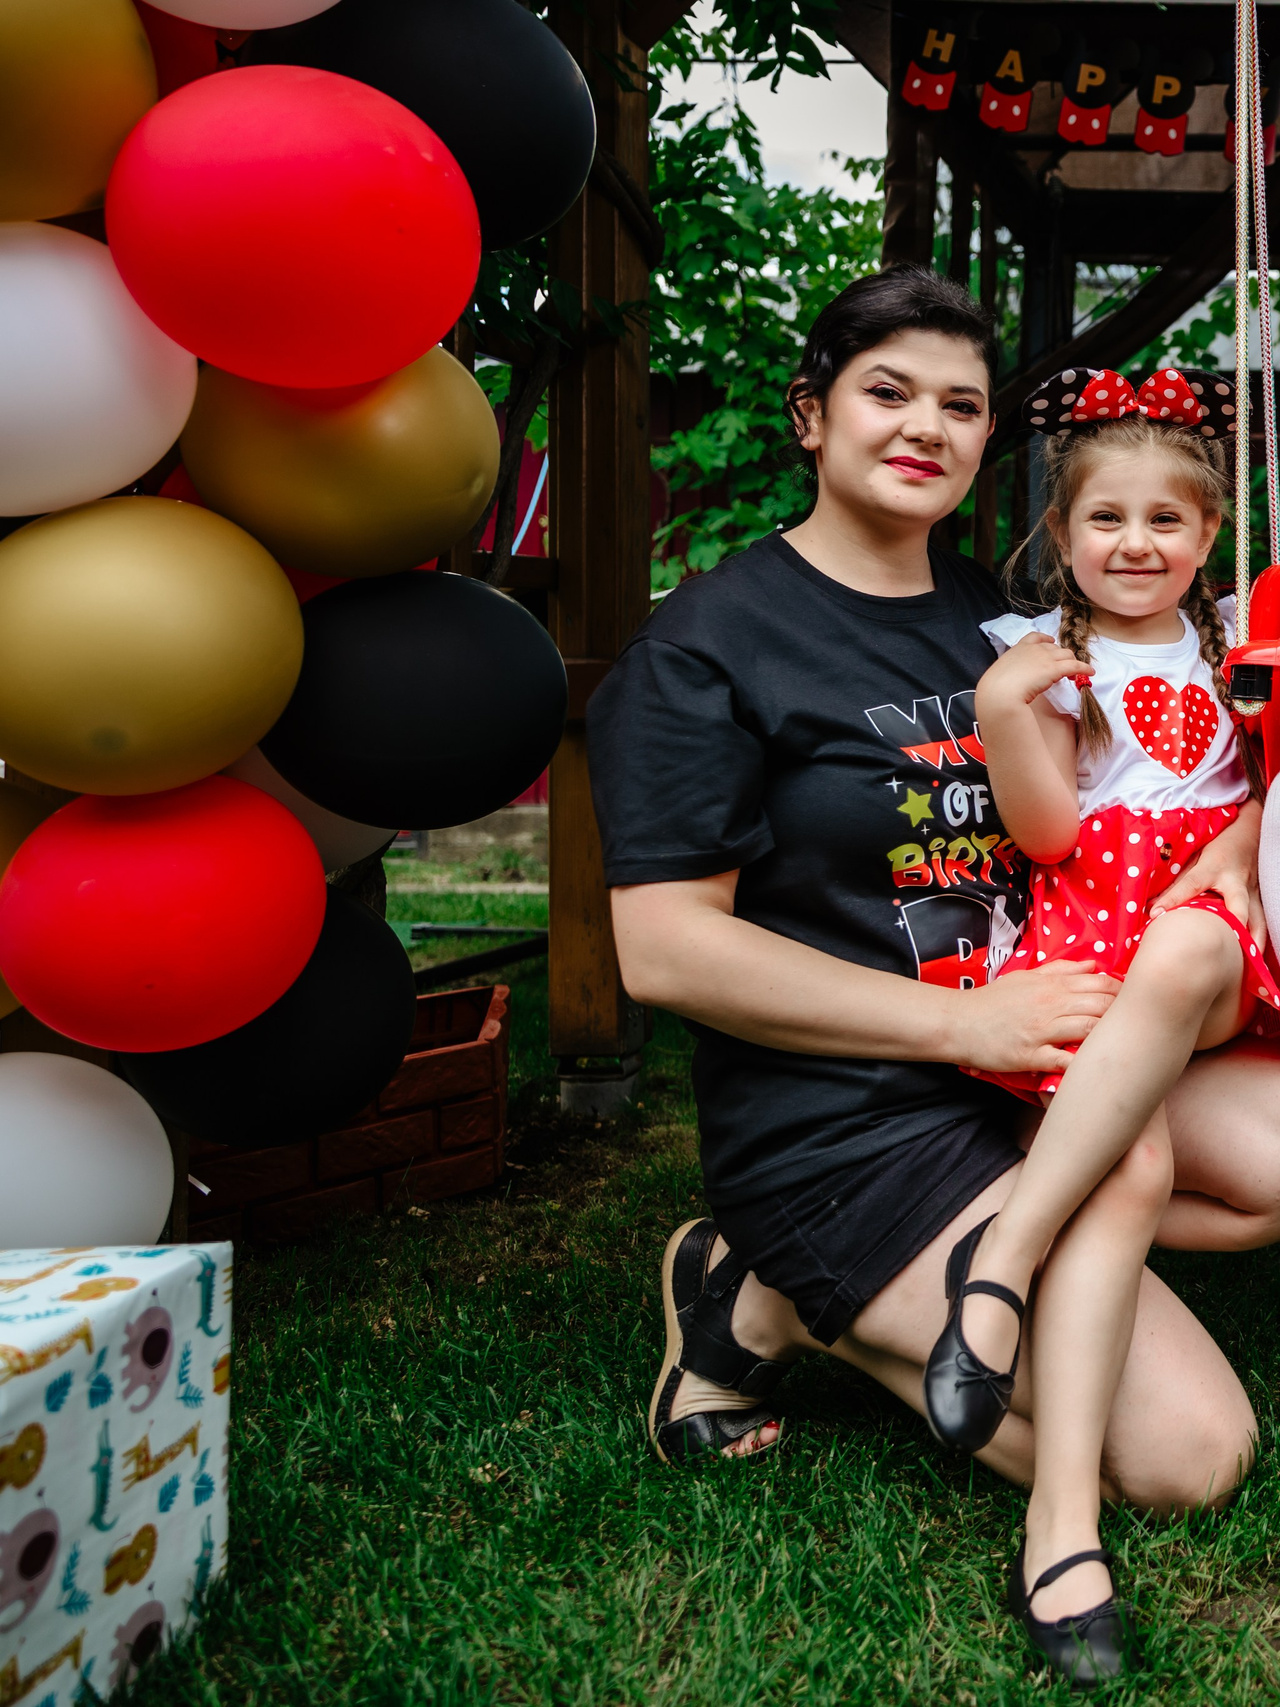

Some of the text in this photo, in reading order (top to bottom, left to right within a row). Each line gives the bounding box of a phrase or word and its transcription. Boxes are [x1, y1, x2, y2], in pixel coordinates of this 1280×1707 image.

[921, 28, 1270, 105] HAPP
[864, 689, 988, 770] MO
[942, 781, 989, 827] OF
